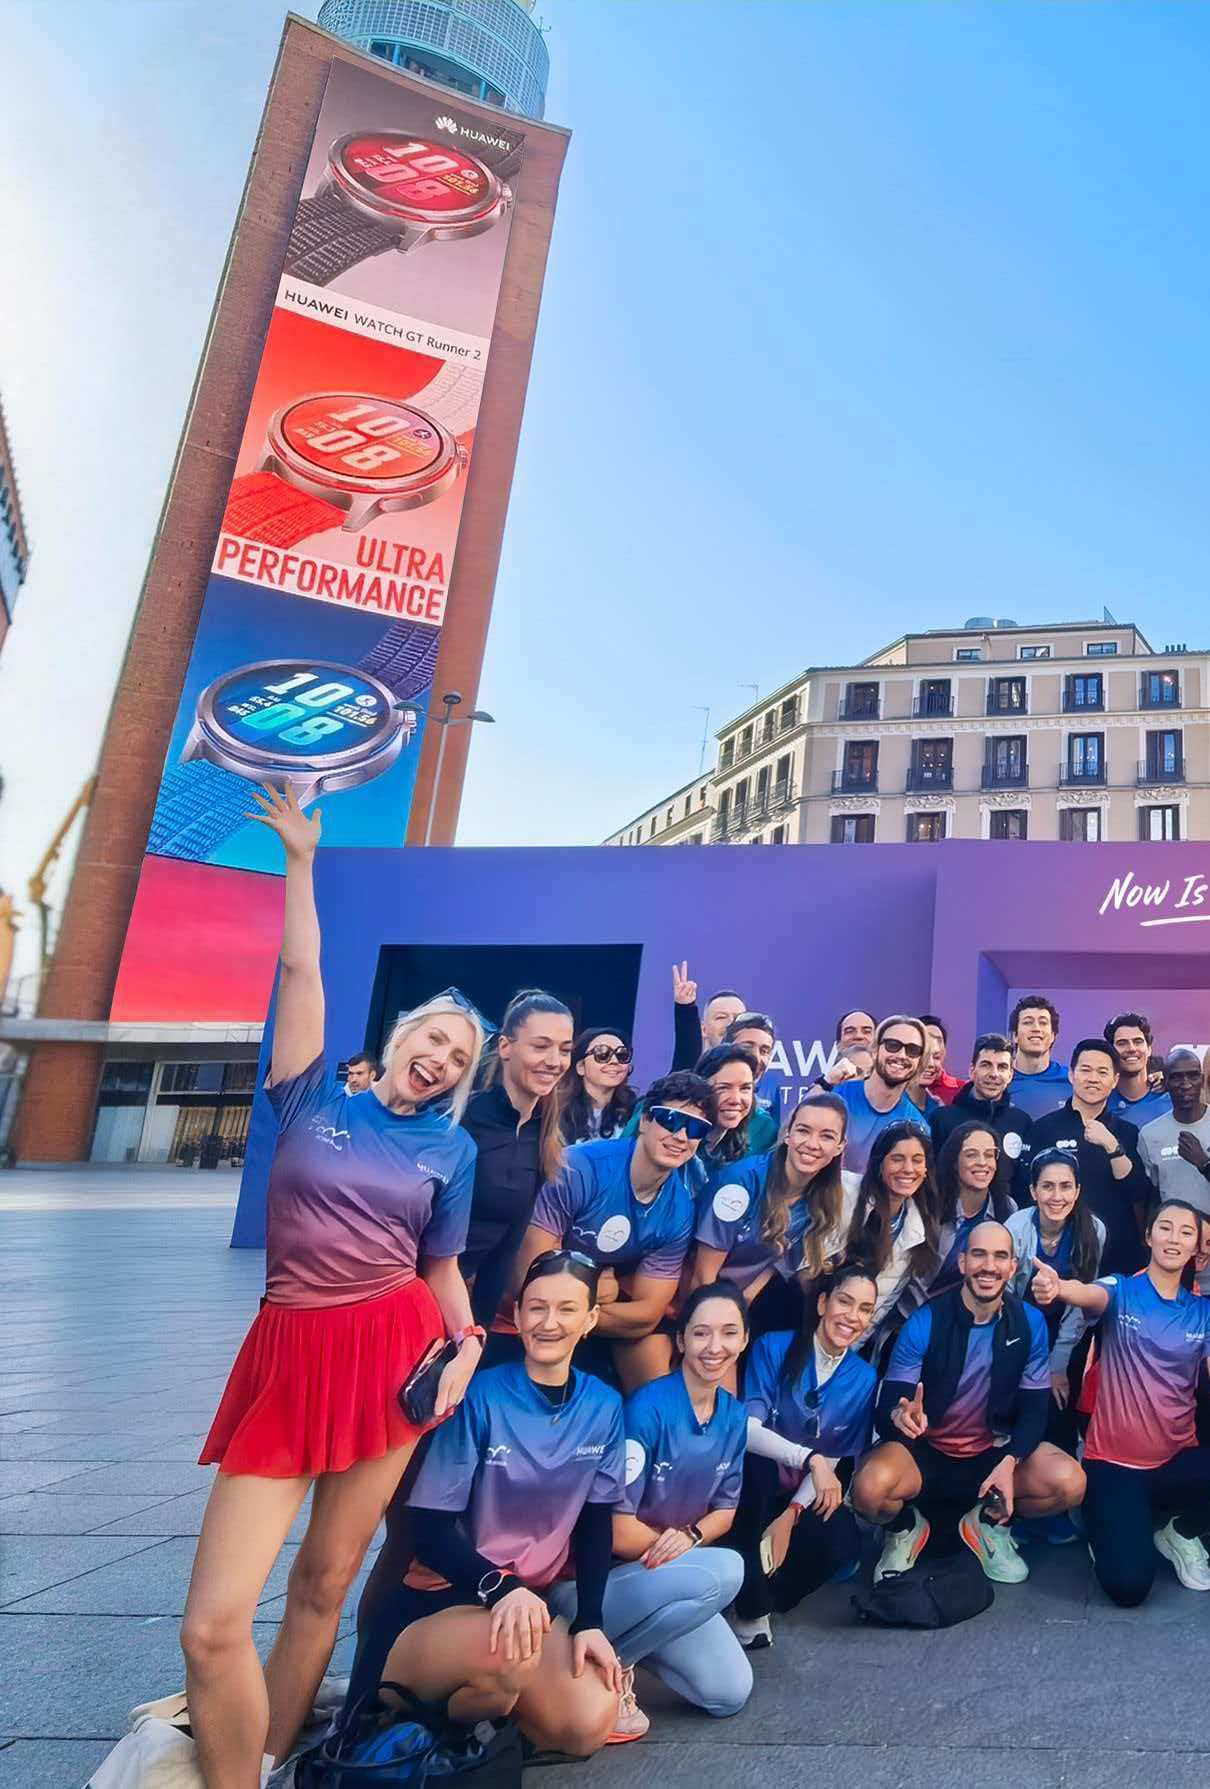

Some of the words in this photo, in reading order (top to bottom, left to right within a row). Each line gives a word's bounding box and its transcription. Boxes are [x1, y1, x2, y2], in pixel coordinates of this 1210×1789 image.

[459, 126, 511, 151] HUAWEI
[284, 288, 349, 321] HUAWEI
[354, 312, 403, 339] WATCH
[405, 330, 424, 348] GT
[427, 335, 471, 358] Runner
[473, 349, 482, 360] 2
[216, 537, 445, 621] PERFORMANCE
[356, 535, 445, 585] ULTRA
[1099, 872, 1170, 915] Now
[1174, 874, 1208, 908] Is
